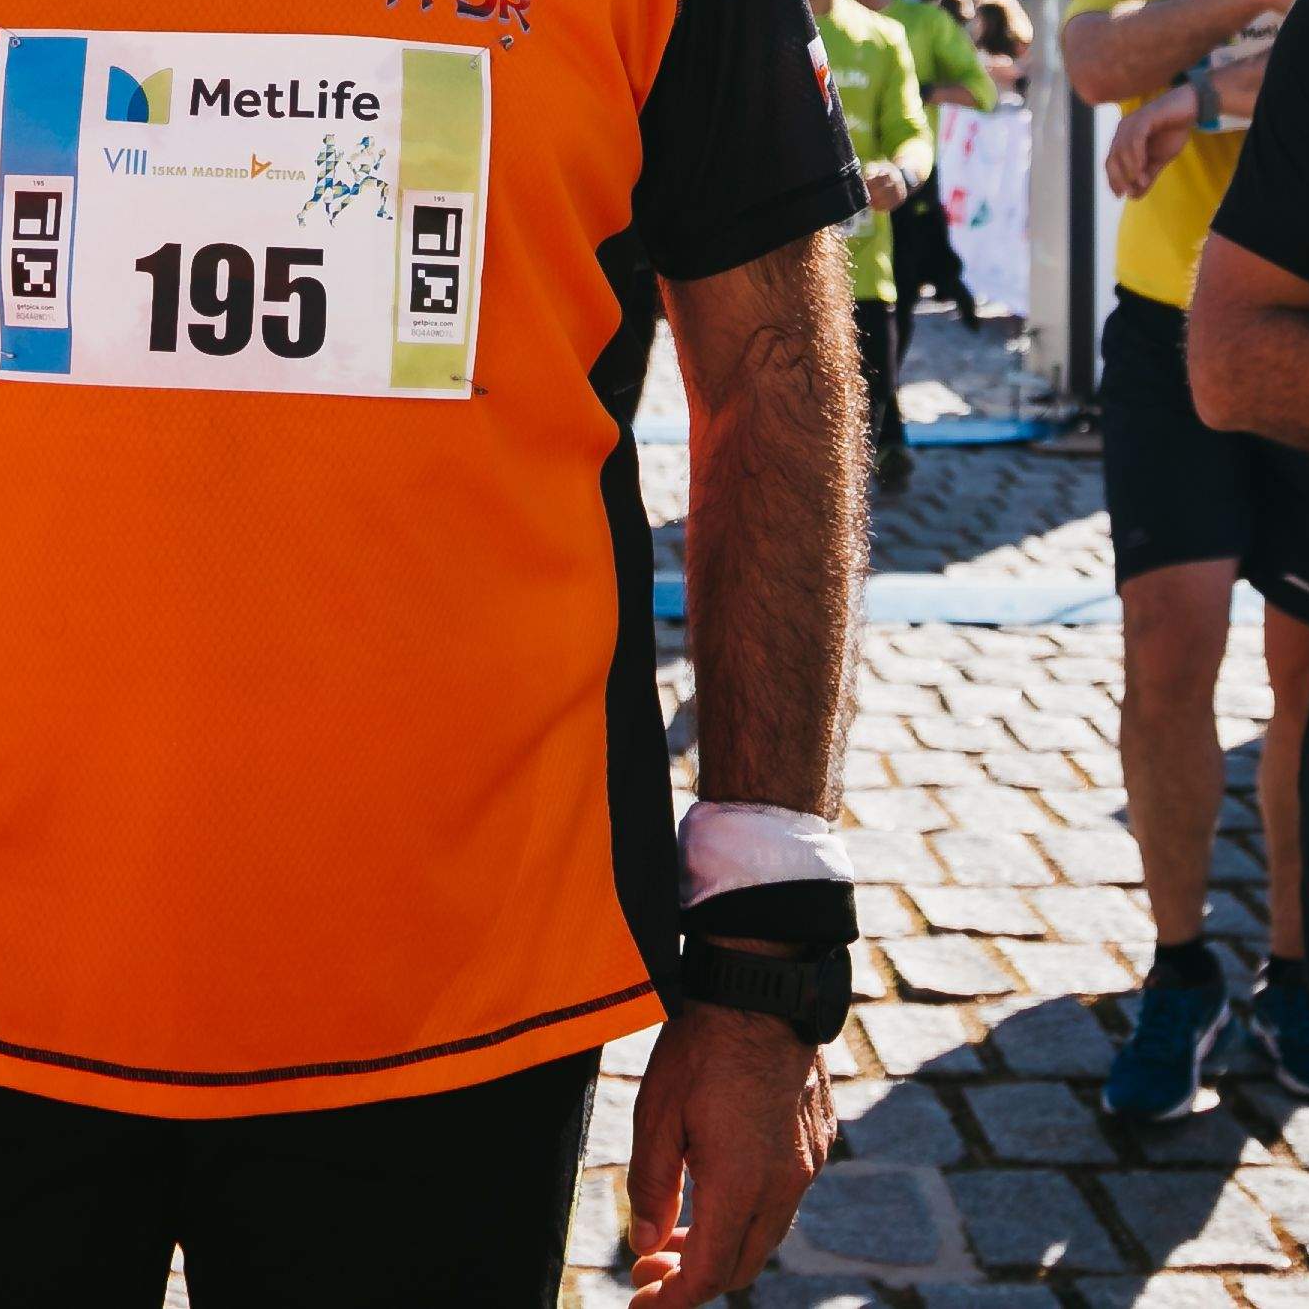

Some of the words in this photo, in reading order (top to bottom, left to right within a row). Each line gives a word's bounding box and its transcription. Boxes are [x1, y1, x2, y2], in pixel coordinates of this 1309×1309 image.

[190, 78, 381, 122] MetLife
[103, 147, 148, 176] VIII
[152, 165, 188, 177] 15KM
[32, 179, 45, 187] 195
[135, 243, 327, 358] 195
